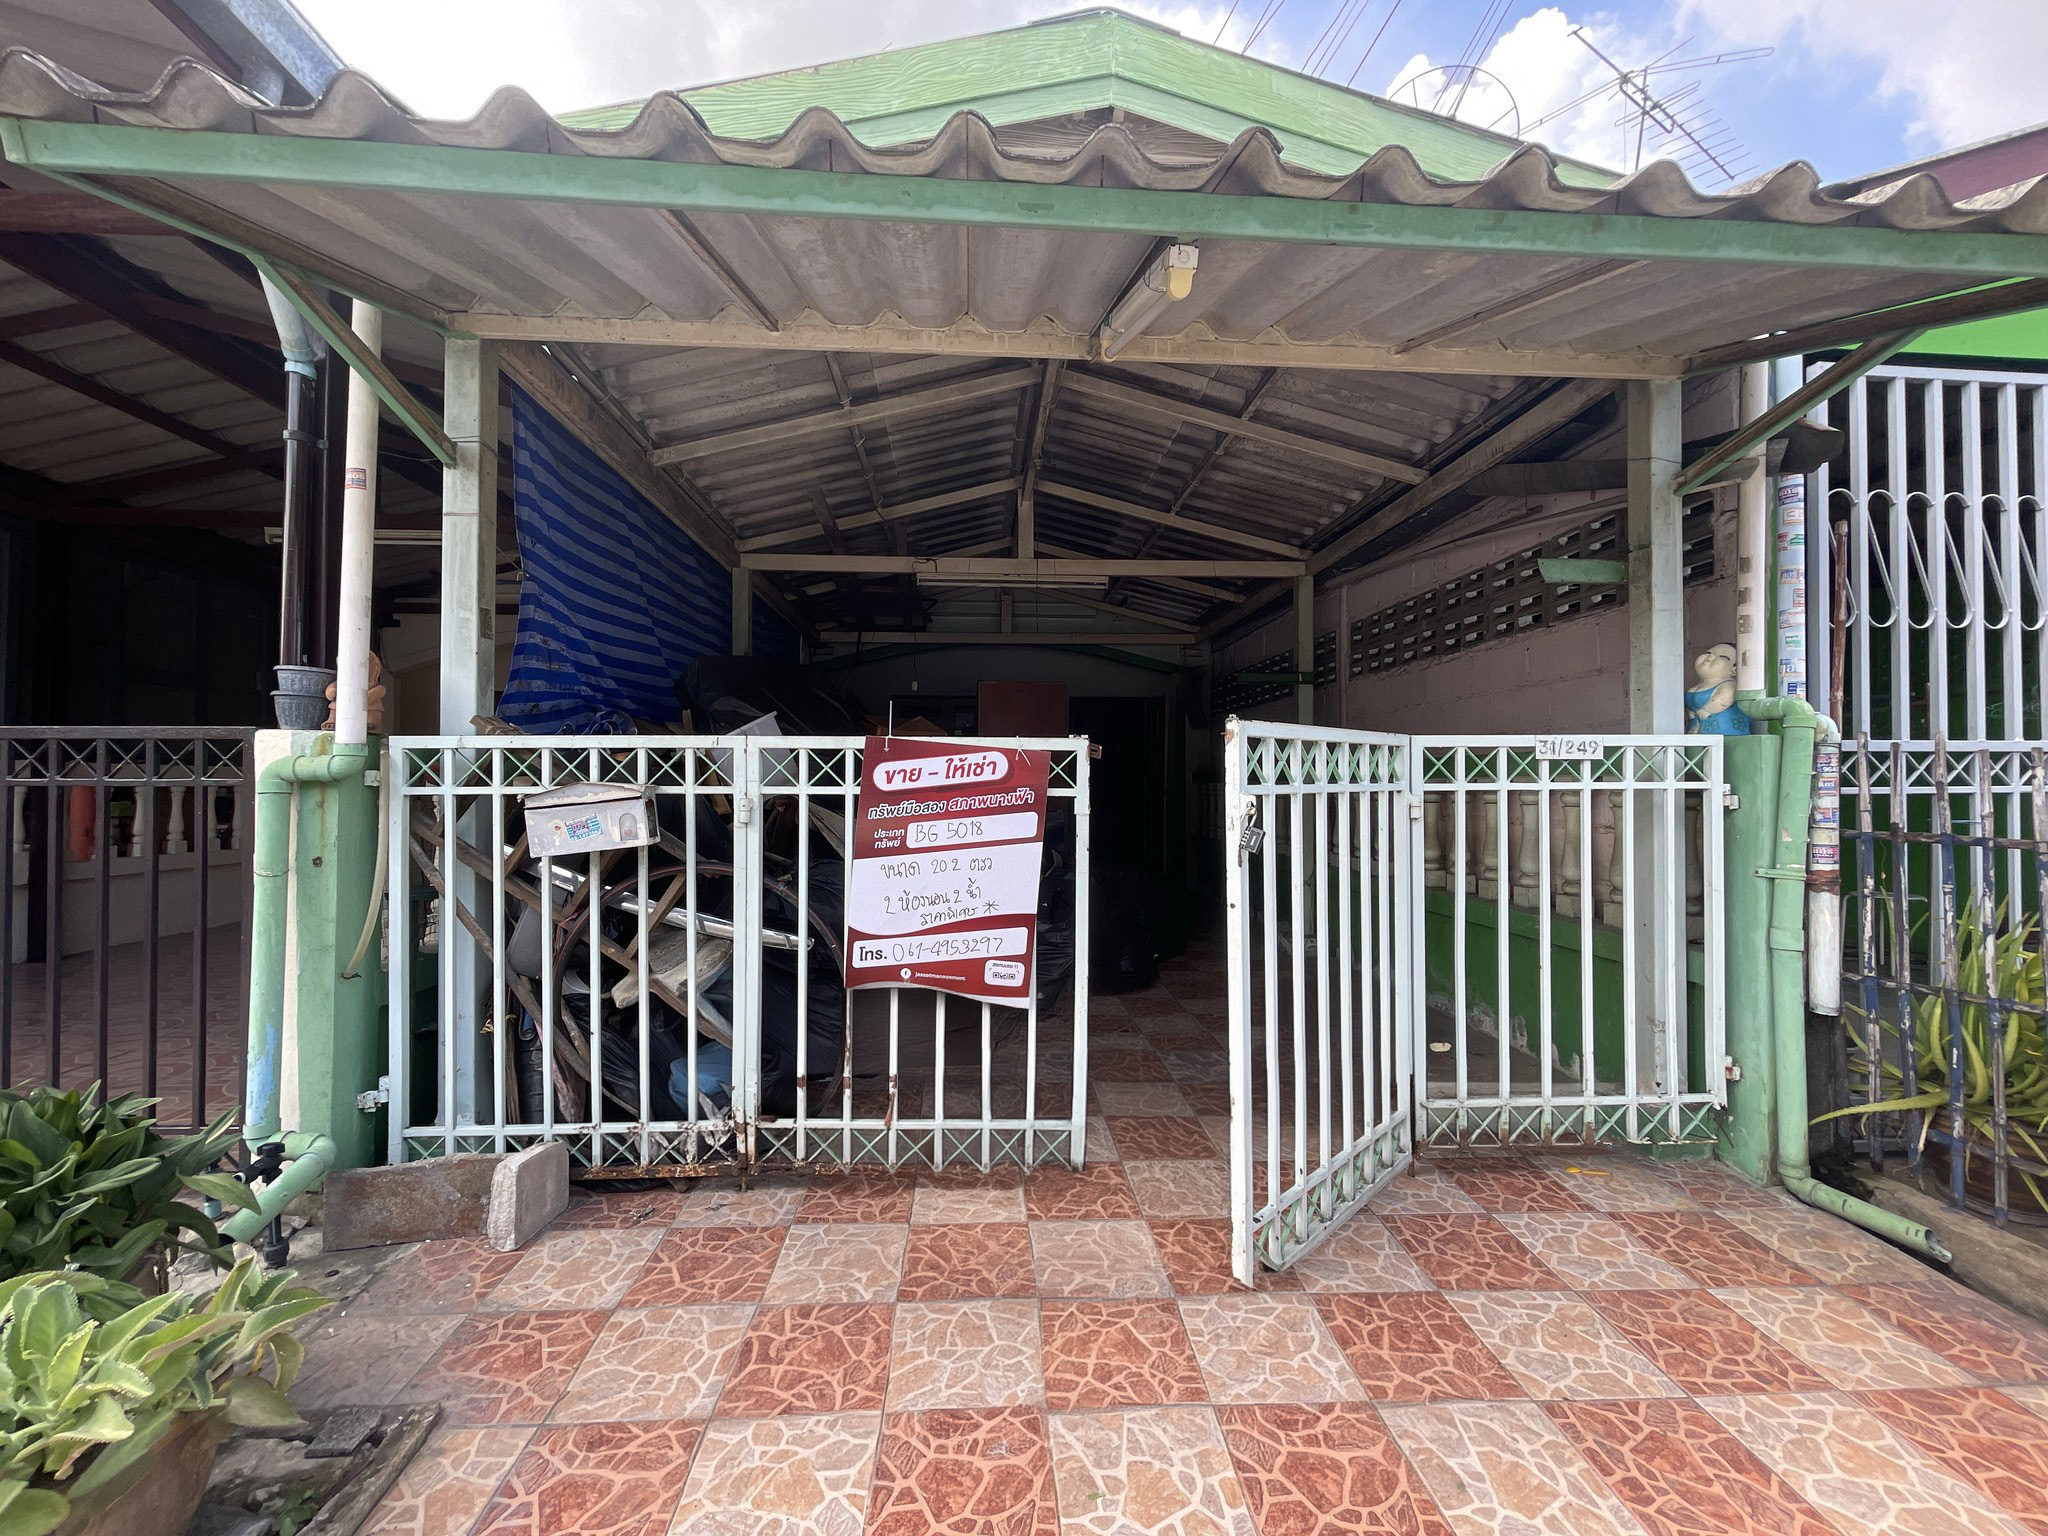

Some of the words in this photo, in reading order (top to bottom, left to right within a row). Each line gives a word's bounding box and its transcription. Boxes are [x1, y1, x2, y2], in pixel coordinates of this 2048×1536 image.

[1537, 737, 1599, 758] 31/249
[884, 767, 922, 785] ขาย
[944, 756, 998, 780] ให้เช่า
[868, 800, 947, 819] ทรัพย์มือสอง
[948, 788, 1035, 811] สภาพนางฟ้า
[874, 828, 904, 838] ประเภท
[915, 823, 938, 842] BG
[946, 821, 984, 839] 5018
[874, 837, 901, 849] ทรัพย์
[880, 861, 920, 879] ขนาด
[892, 936, 1003, 962] 061-4953297
